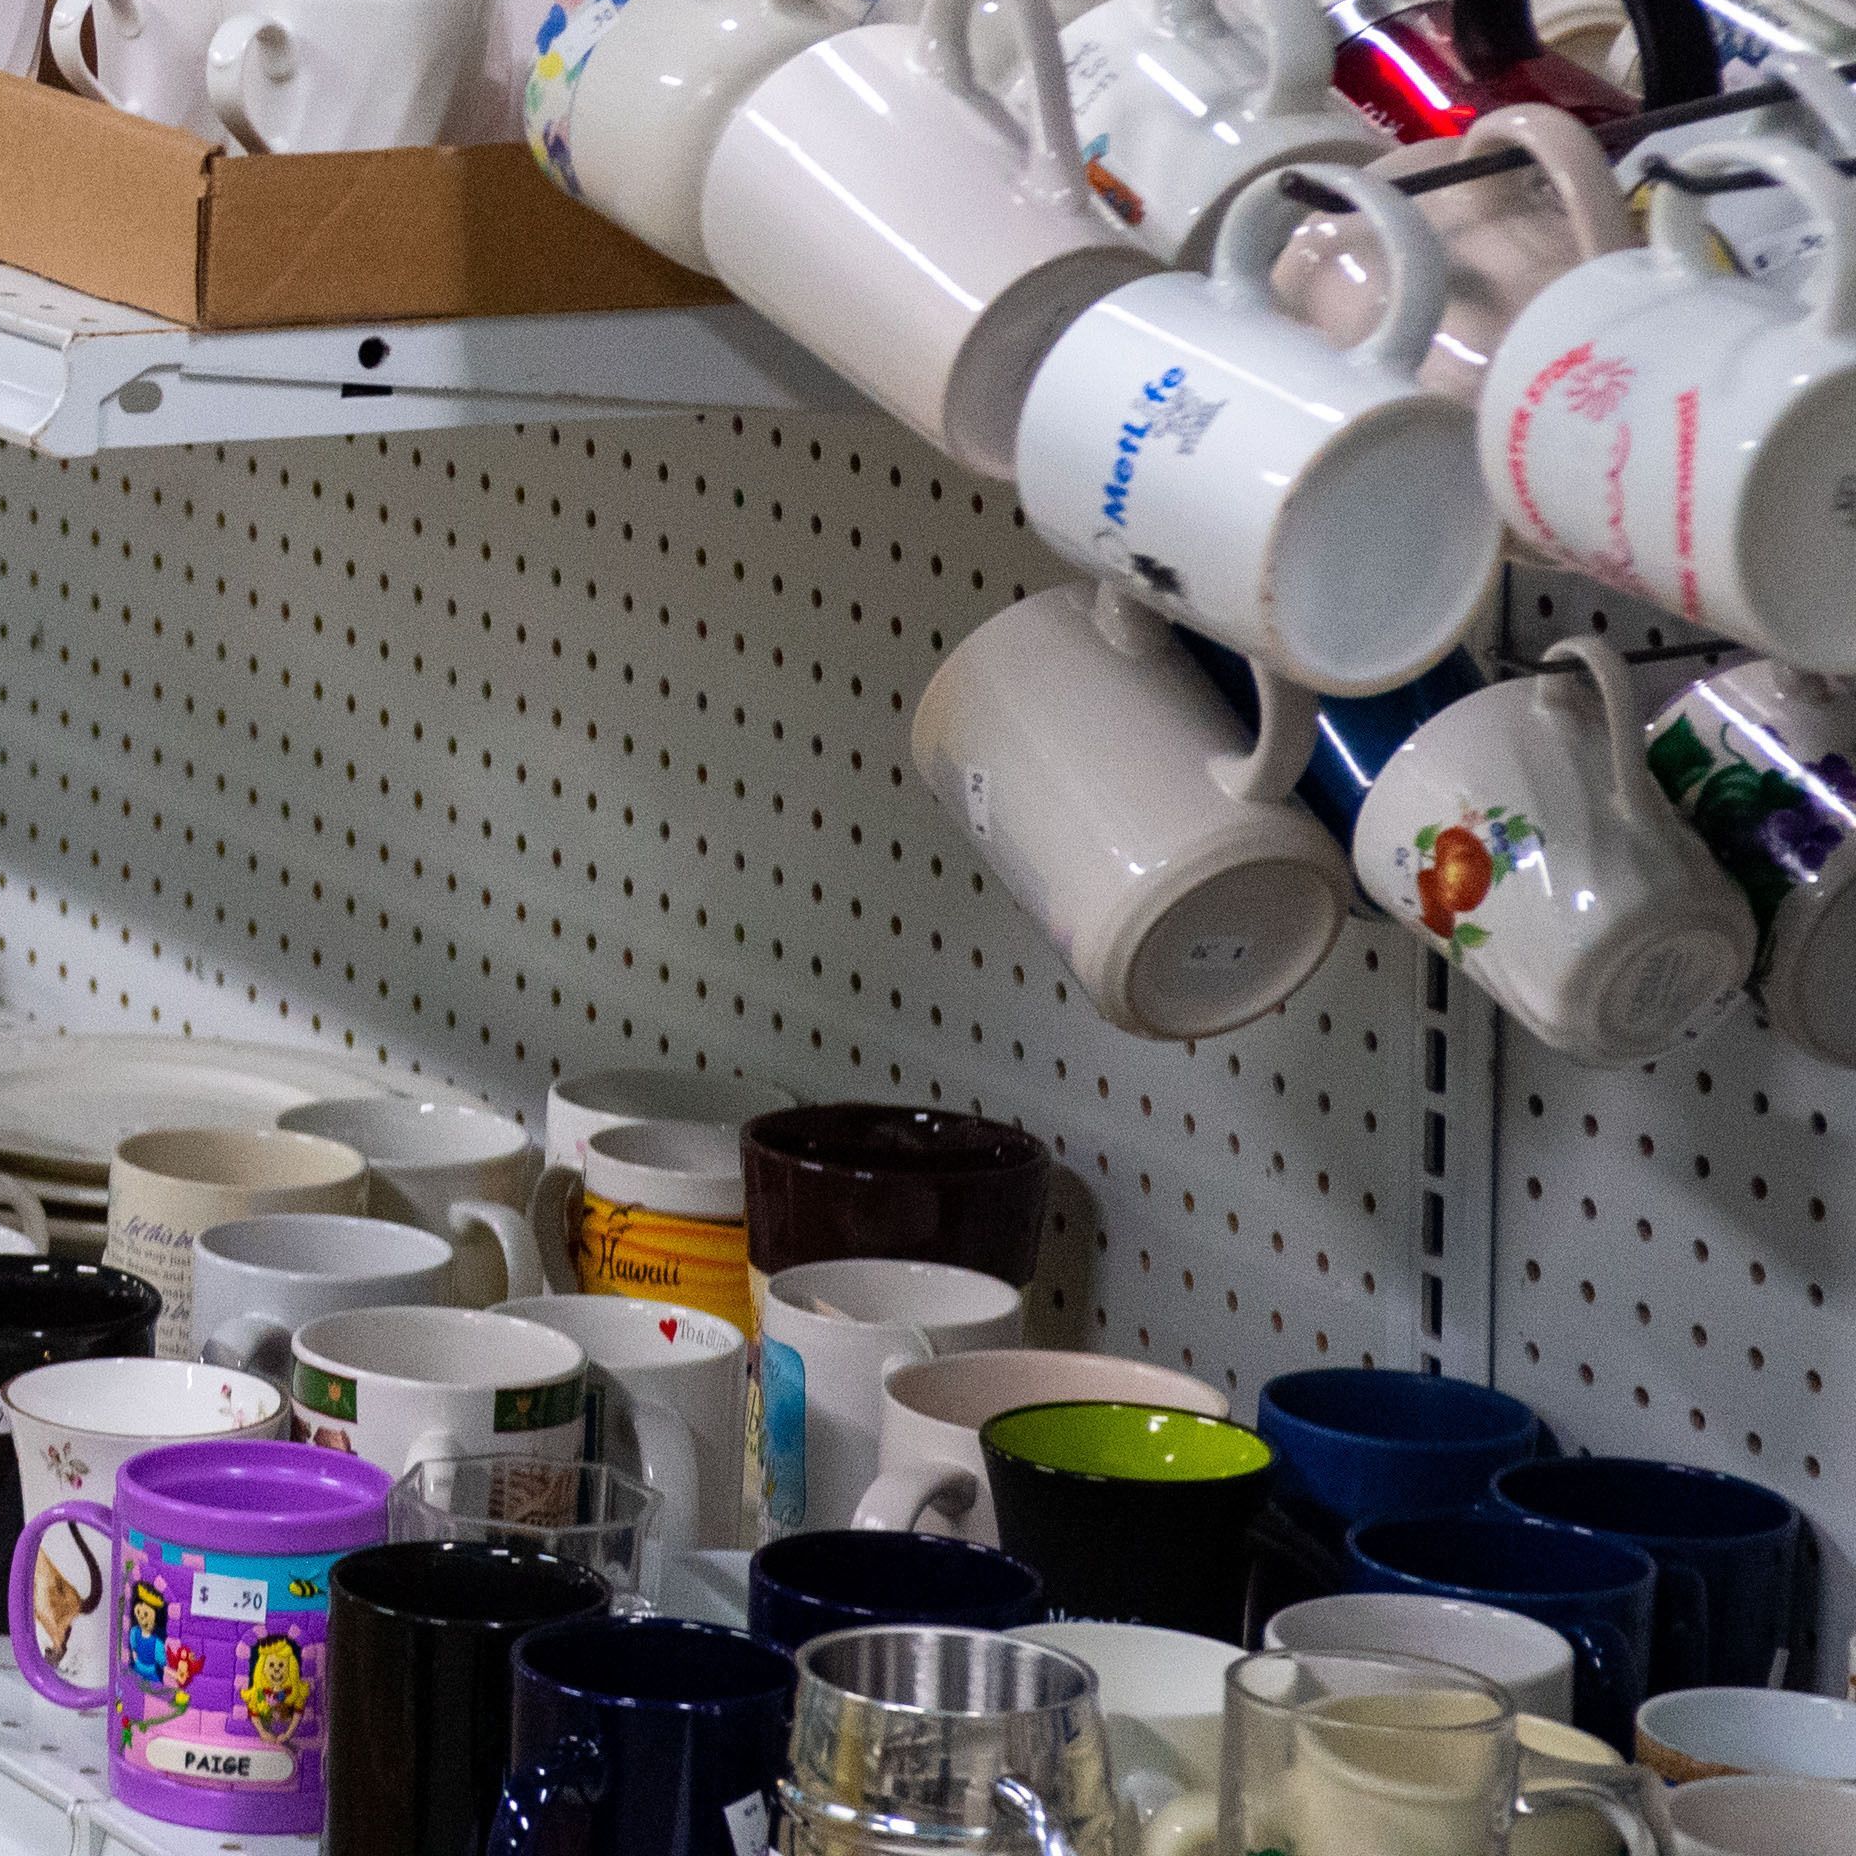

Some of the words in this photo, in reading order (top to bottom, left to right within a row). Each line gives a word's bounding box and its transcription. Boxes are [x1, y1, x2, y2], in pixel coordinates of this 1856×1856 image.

[1101, 365, 1187, 529] MetLfe
[598, 1232, 682, 1286] Hawaii
[232, 1590, 263, 1611] .50
[184, 1749, 252, 1777] PAIGE
